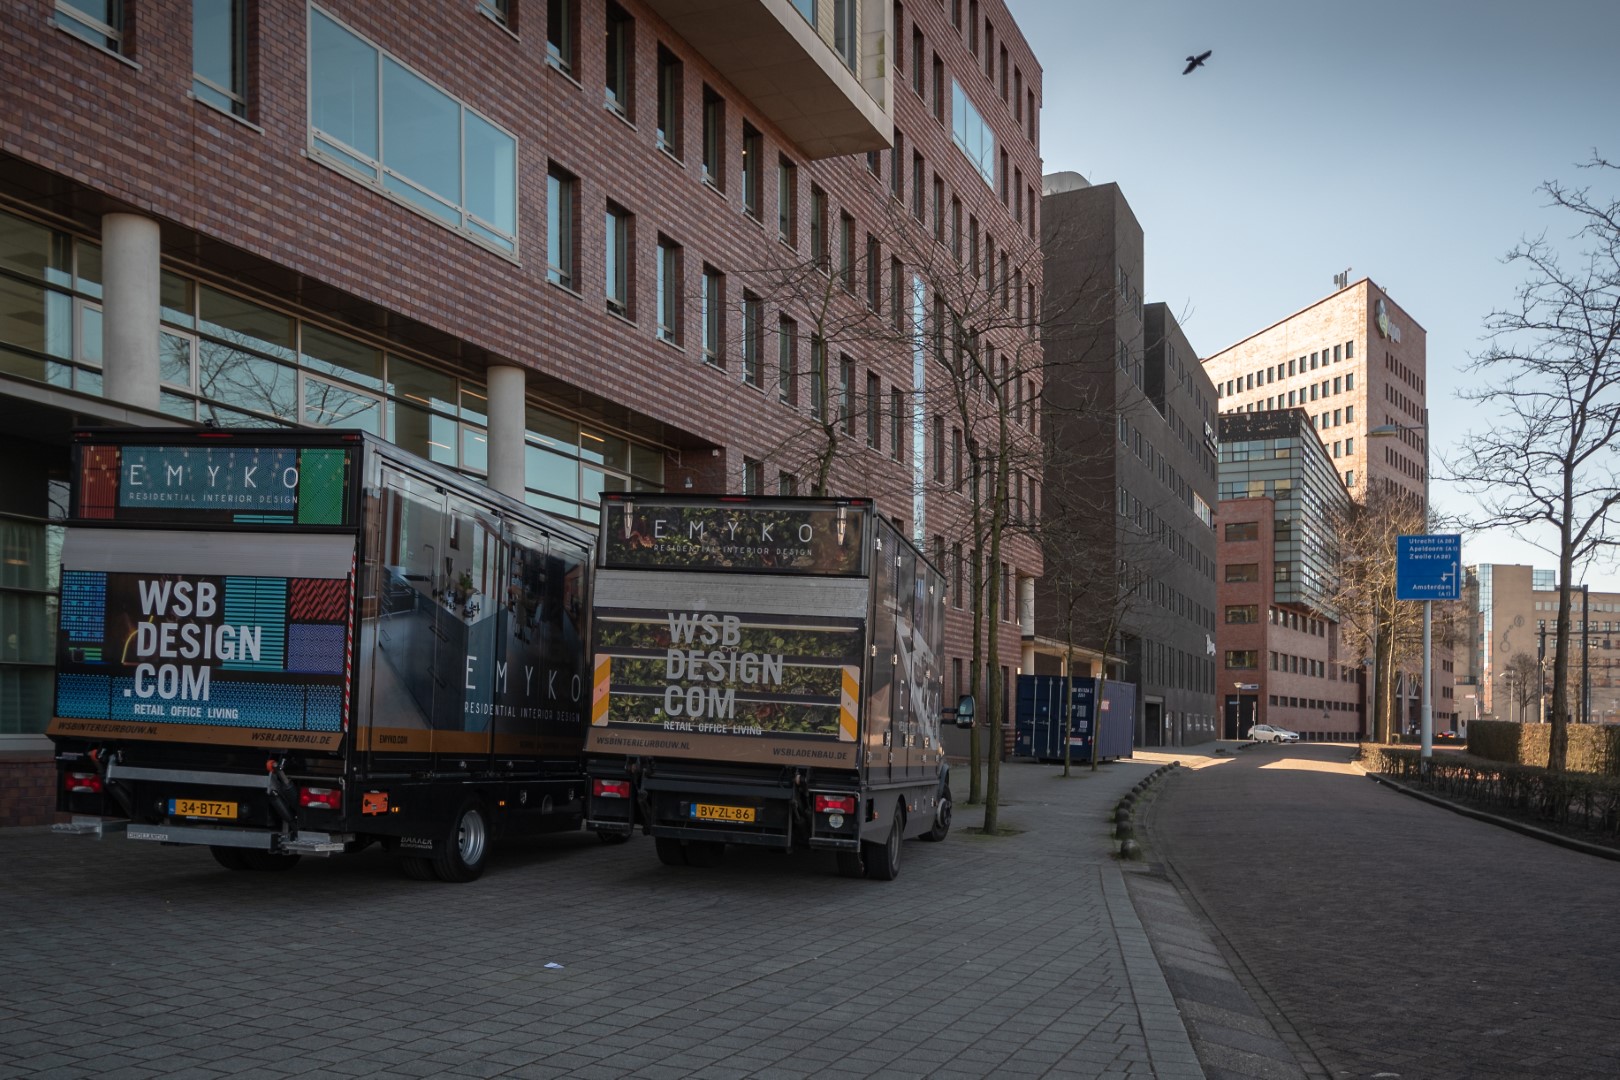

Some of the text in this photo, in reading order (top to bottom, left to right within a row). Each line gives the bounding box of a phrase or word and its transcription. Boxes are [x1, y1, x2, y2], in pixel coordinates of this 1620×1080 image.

[129, 464, 299, 489] EMYKO
[128, 491, 299, 505] RESIDENTIAL INTERIOR DESIGN
[654, 519, 813, 543] EMYKO
[653, 544, 813, 557] RESIDENTIAL INTERIOR DESIGN
[1408, 545, 1443, 553] Apeldoorn
[138, 579, 217, 618] WSB
[667, 612, 741, 646] WSB
[136, 620, 262, 662] DESIGN
[665, 648, 784, 685] DESIGN
[123, 662, 211, 702] .COM
[465, 655, 581, 702] EMYKO
[654, 684, 736, 720] .COM
[133, 703, 239, 720] RETAIL OFFICE LIVING
[464, 701, 580, 723] RESIDENTIAL INTERIOR DESIGN
[57, 721, 159, 735] WSBINTERIEURBOUW.NL
[663, 720, 763, 736] RETAIL OFFICE LIVING
[251, 731, 333, 746] WSBLADENBAU.DE
[595, 735, 691, 750] WSBINTERIEURBOUW.NL
[771, 747, 848, 760] WSBLADENBAU.DE
[180, 801, 231, 817] 34-BTZ-1
[700, 805, 751, 820] BV-ZL-86
